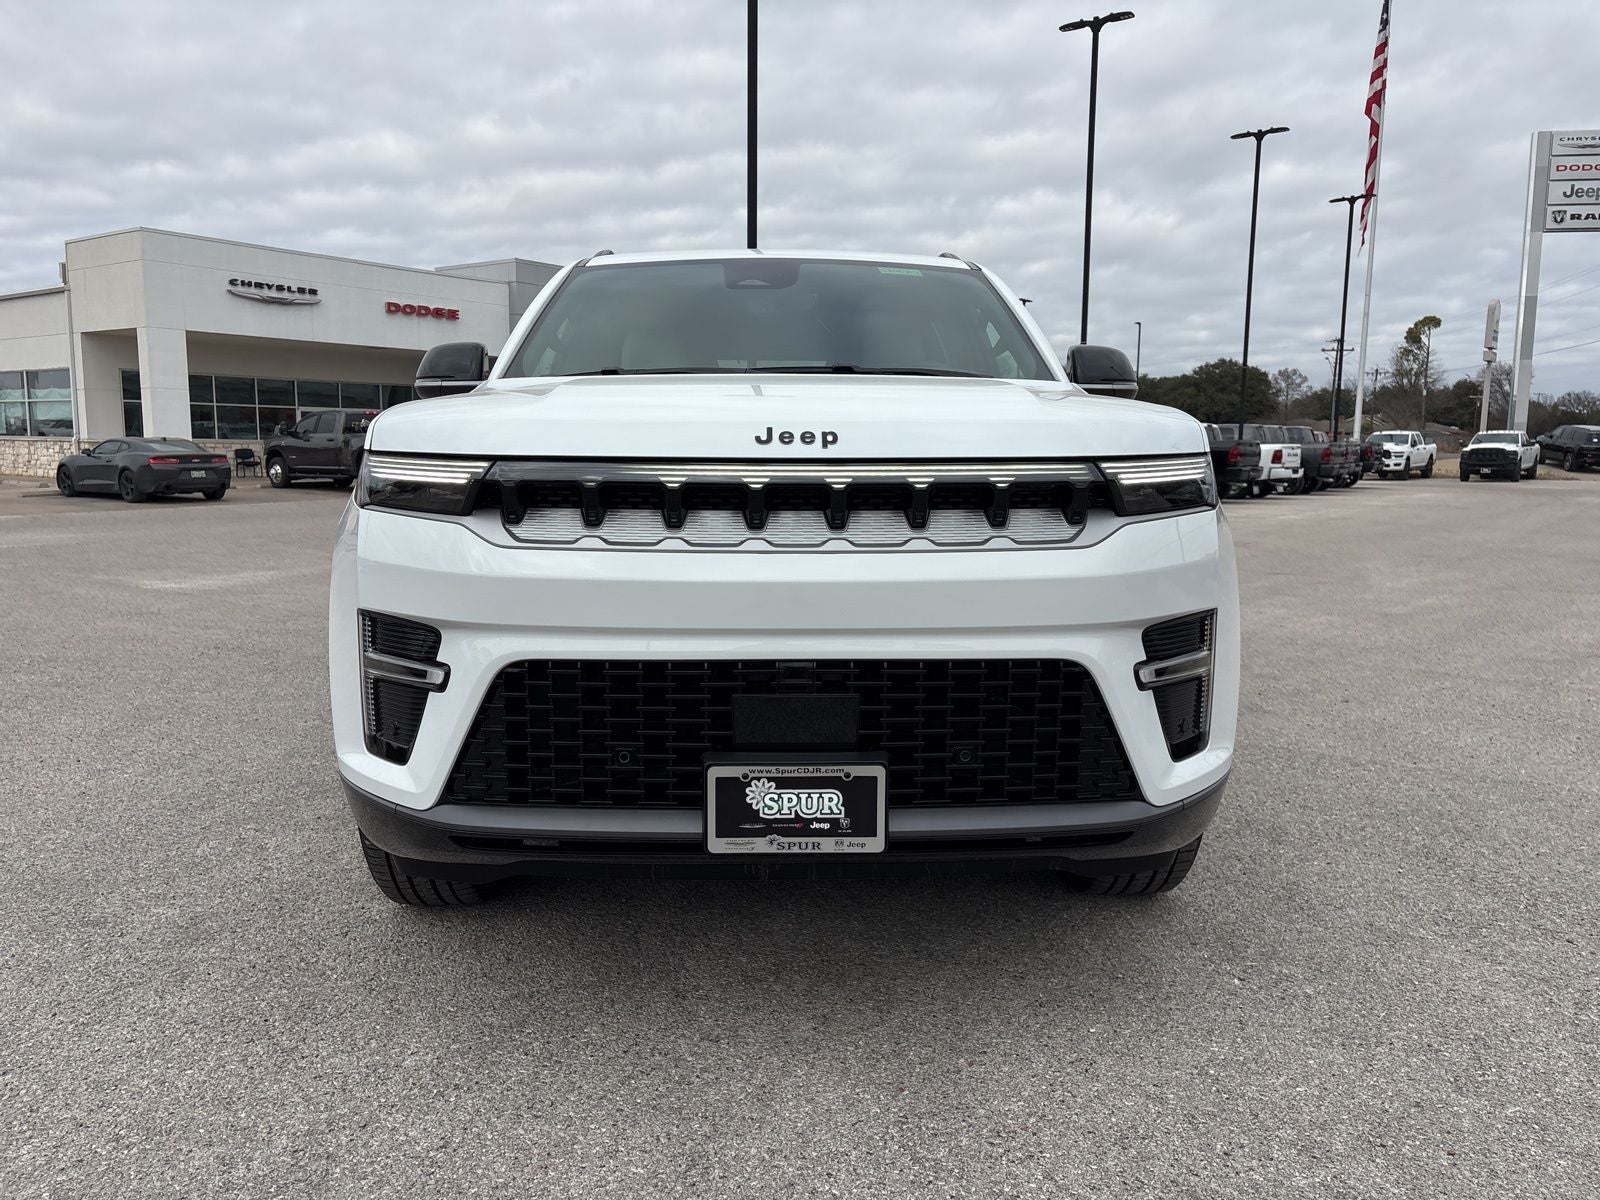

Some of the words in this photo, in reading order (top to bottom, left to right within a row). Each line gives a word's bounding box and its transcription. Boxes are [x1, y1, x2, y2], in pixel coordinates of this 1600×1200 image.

[228, 278, 319, 295] CHRYSLER
[385, 301, 460, 320] DODGE
[754, 426, 839, 449] Jeep
[748, 767, 845, 776] www.SpurCDJR.com
[762, 791, 841, 816] SPUR
[810, 821, 830, 829] Jeep
[776, 841, 822, 850] SPUR
